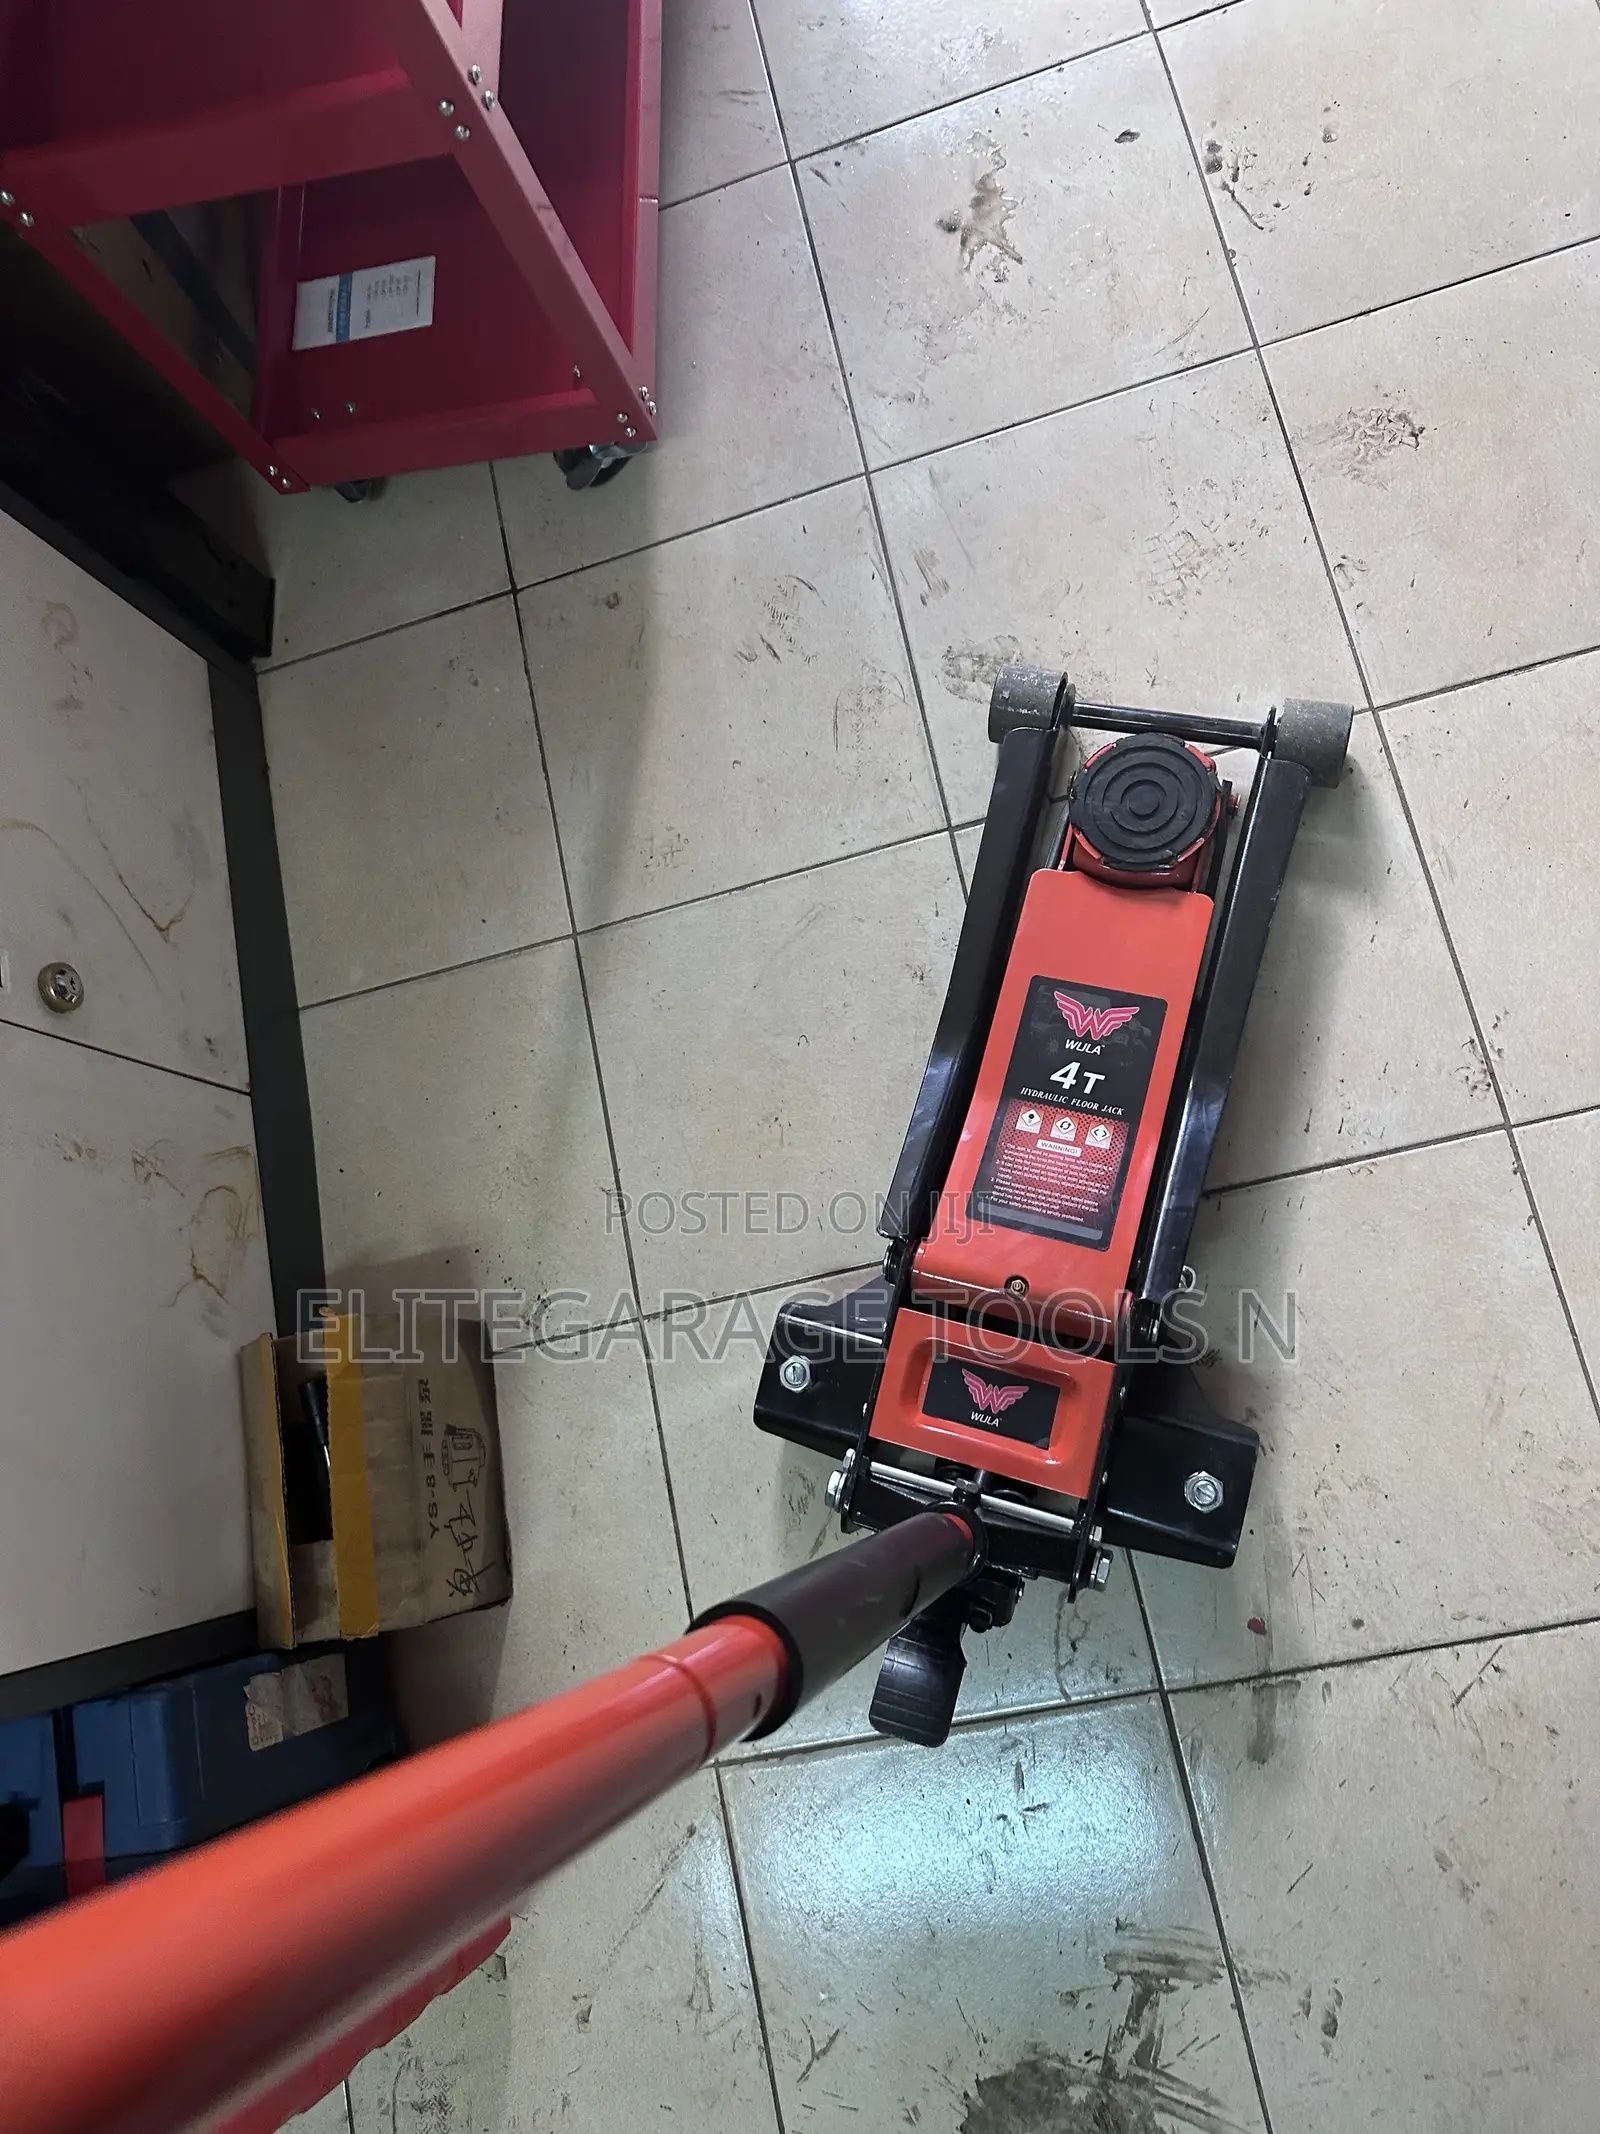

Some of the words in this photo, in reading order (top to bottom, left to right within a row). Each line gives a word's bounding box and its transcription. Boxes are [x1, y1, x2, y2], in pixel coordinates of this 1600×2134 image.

[1065, 1039, 1101, 1055] WULA
[1020, 1087, 1069, 1104] HYDRAULIC
[1070, 1098, 1099, 1111] FLOOR
[1101, 1105, 1124, 1116] JACK
[1040, 1141, 1078, 1155] WARNING!
[970, 1411, 1000, 1427] WULA
